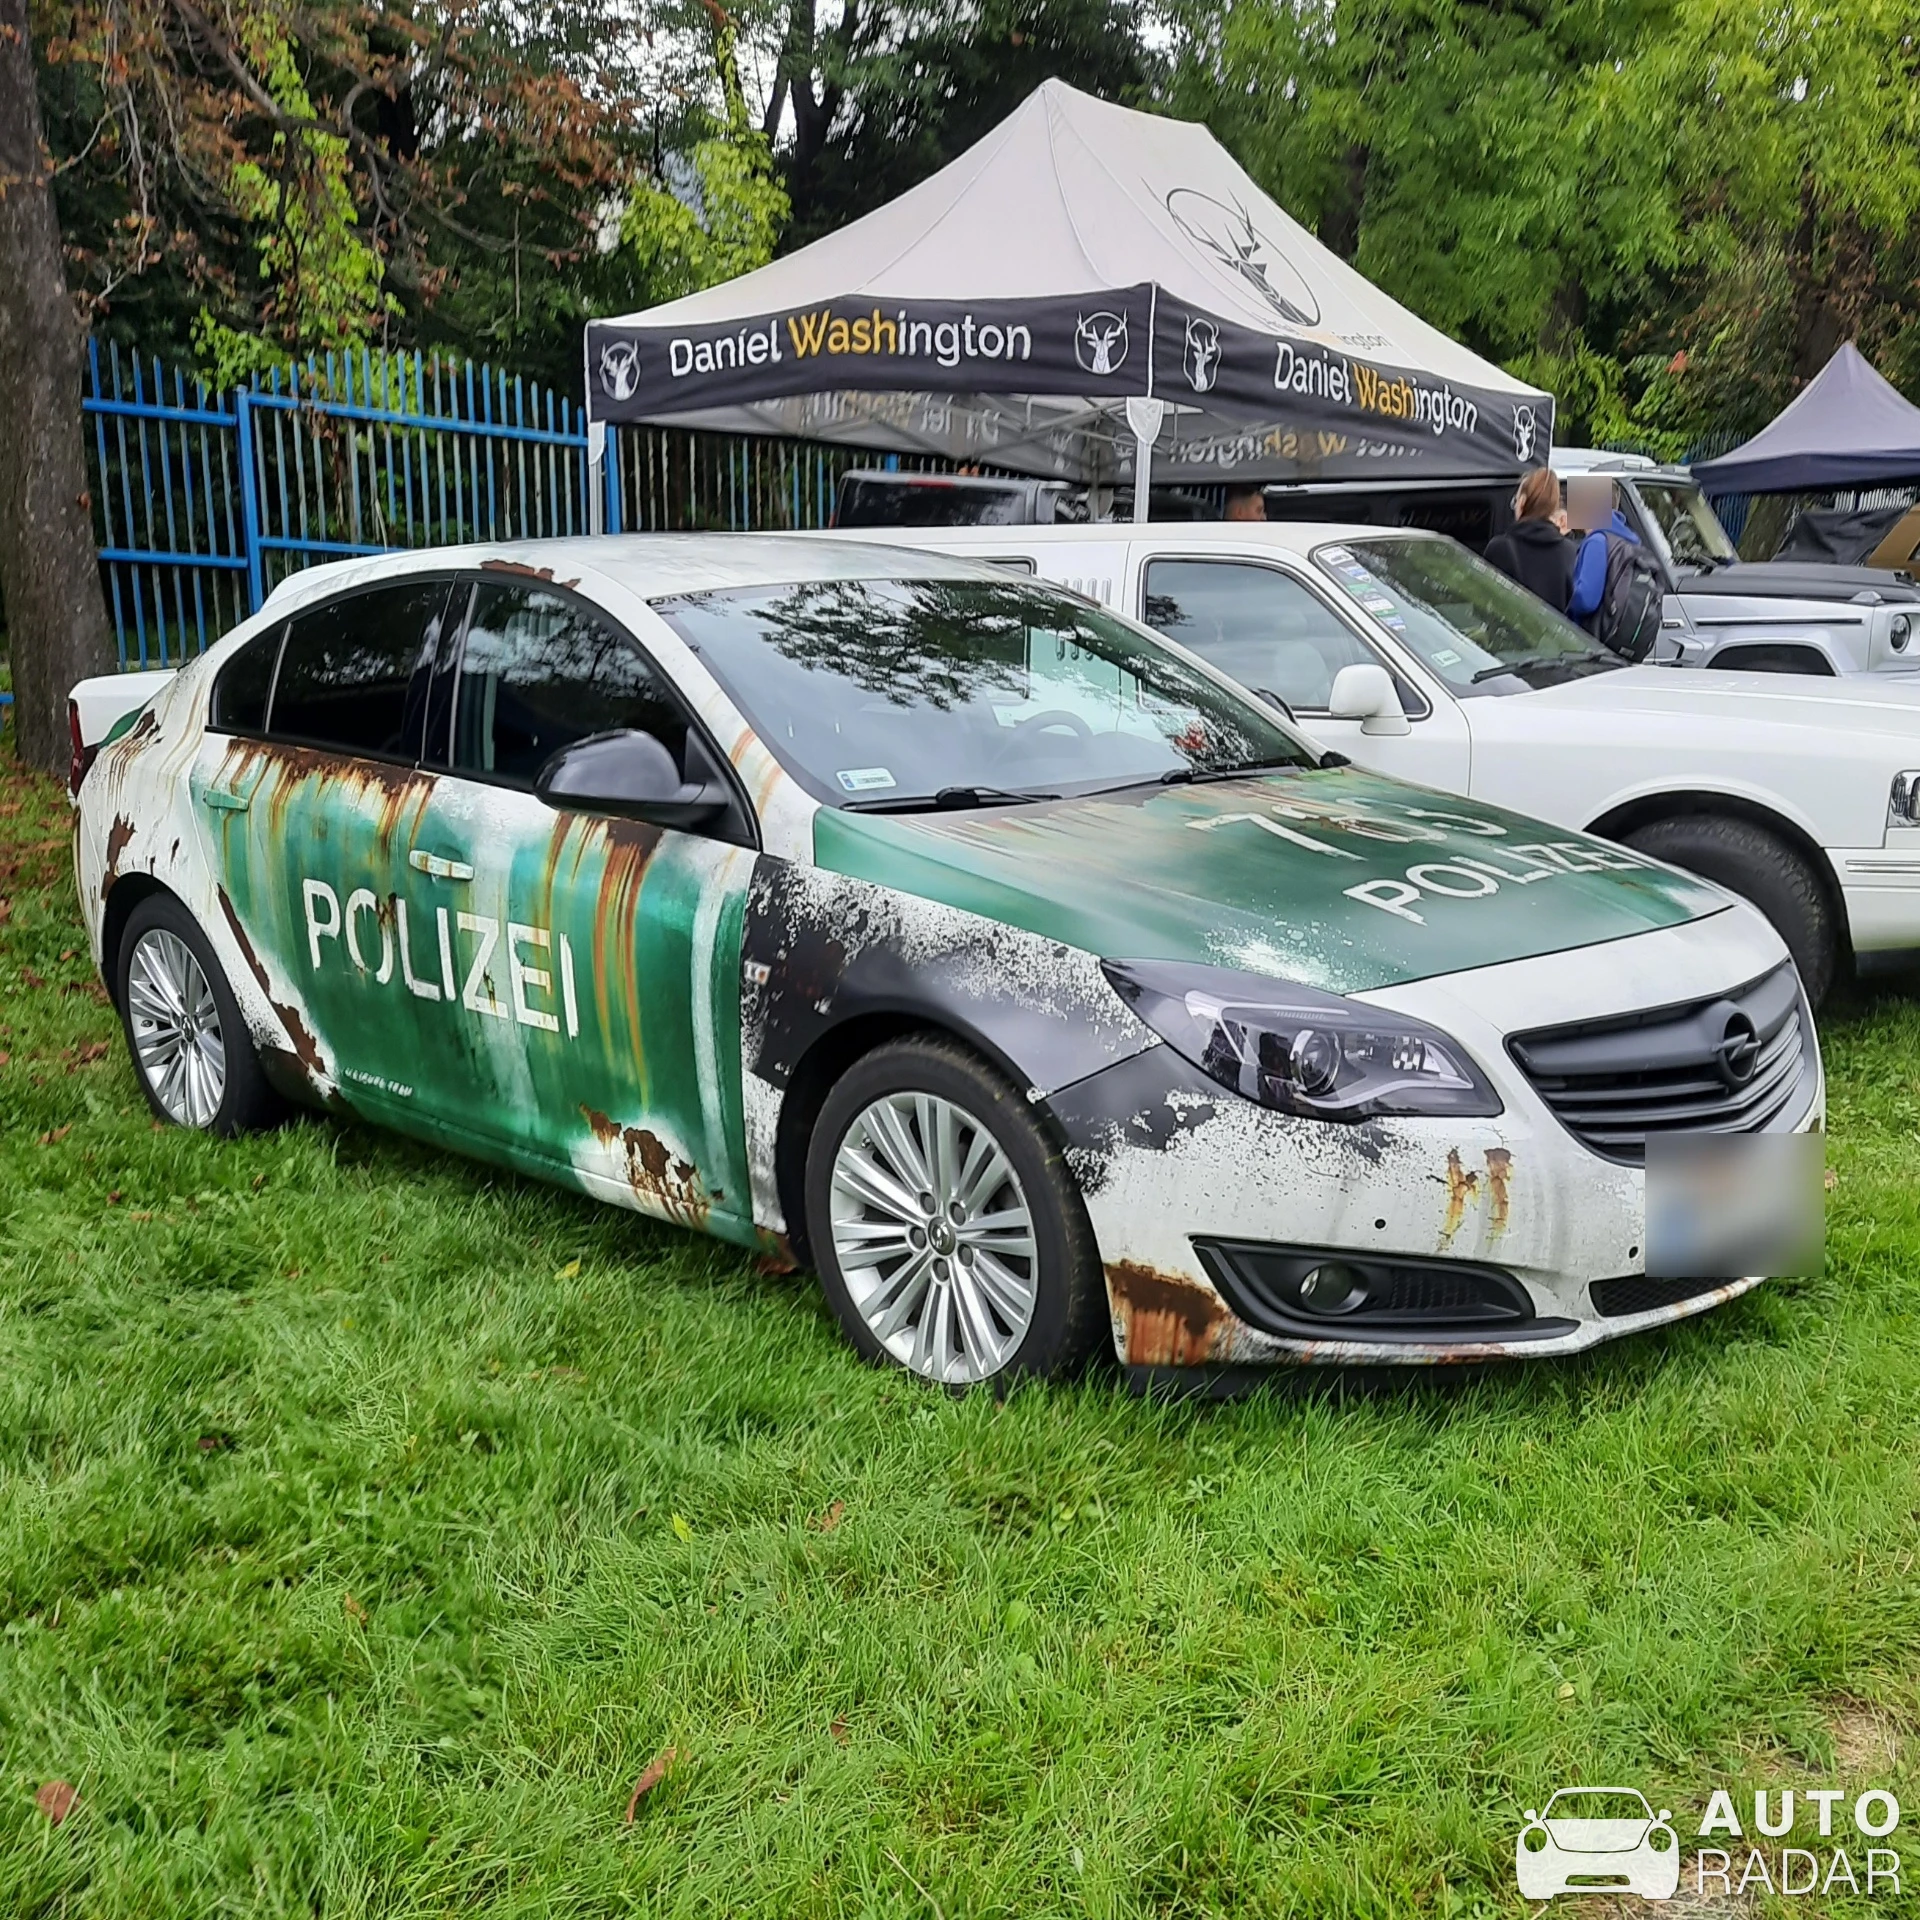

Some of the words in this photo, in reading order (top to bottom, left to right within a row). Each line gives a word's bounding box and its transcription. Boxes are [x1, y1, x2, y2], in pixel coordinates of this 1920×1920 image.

[786, 308, 1032, 367] Washington
[1274, 341, 1352, 406] Daniel
[1353, 362, 1479, 434] Washington
[1343, 842, 1658, 926] POLIZEI
[302, 878, 579, 1040] POLIZEI
